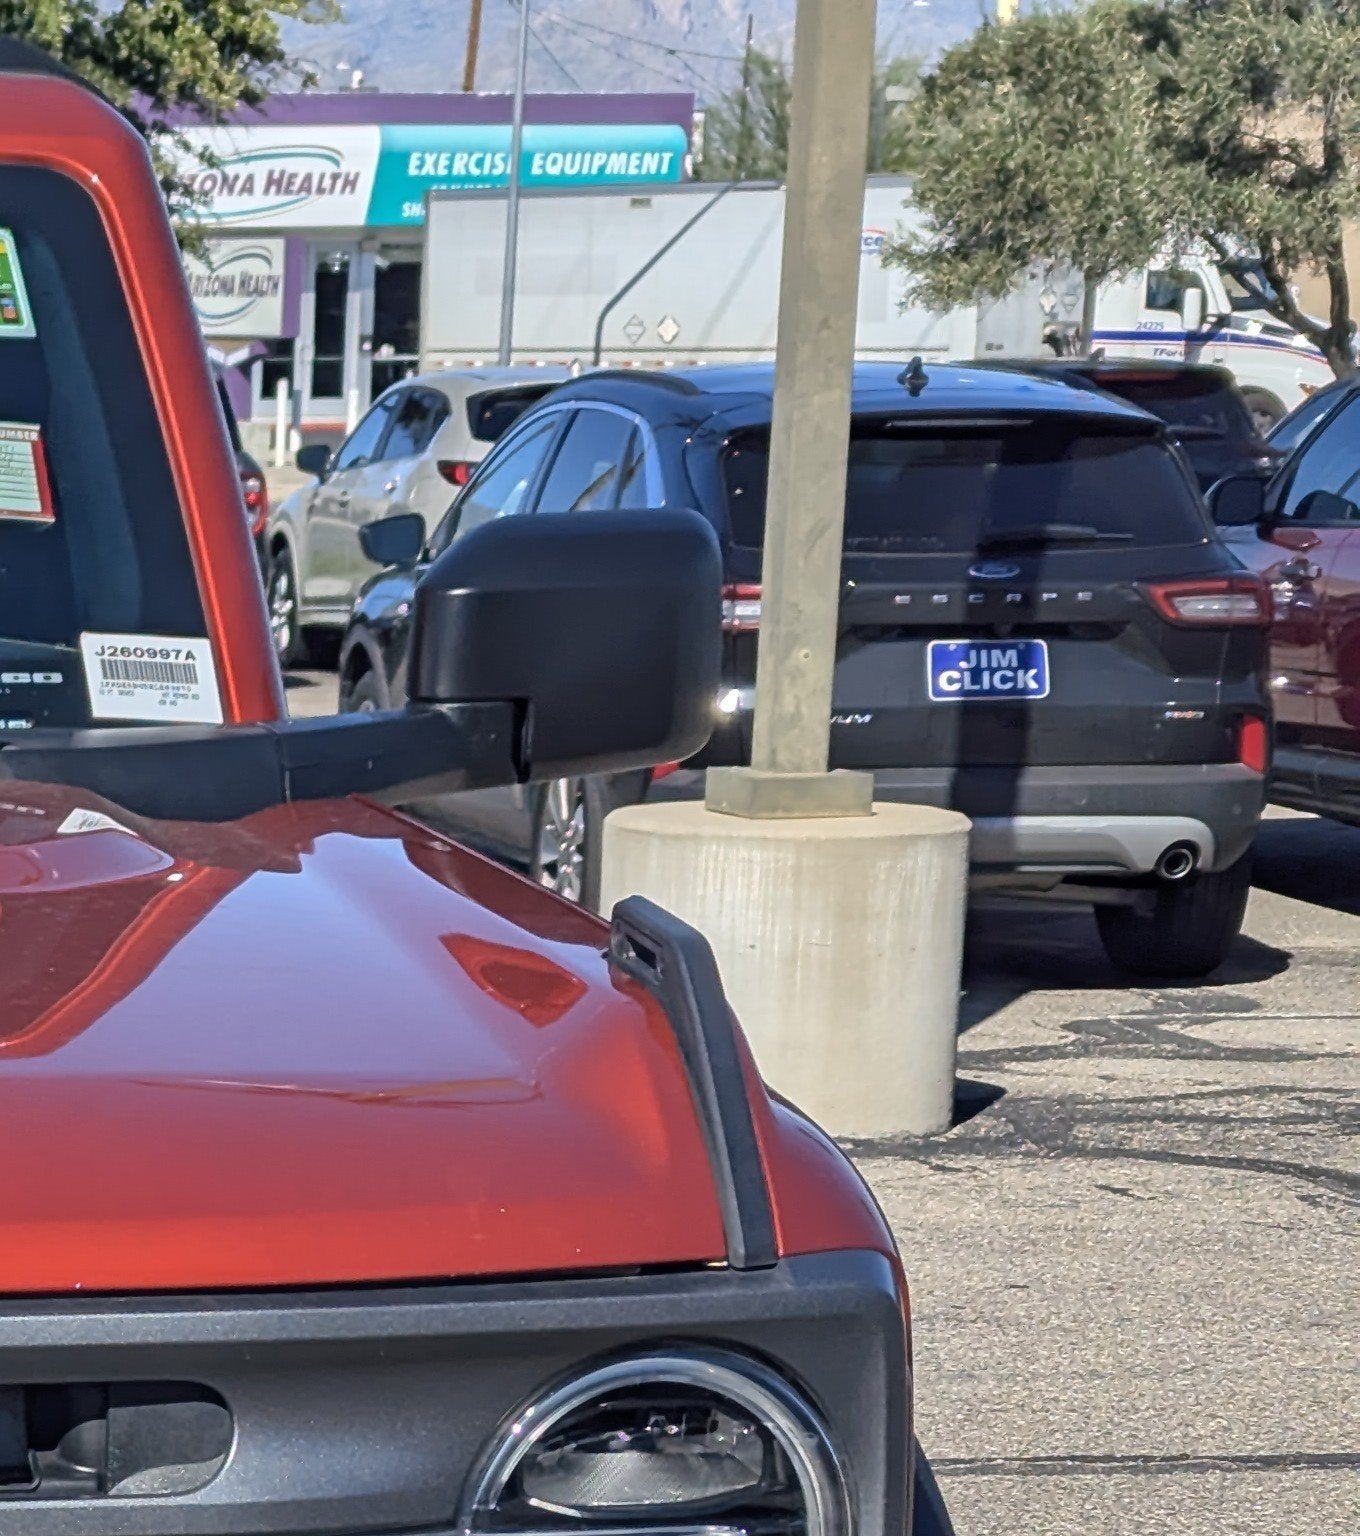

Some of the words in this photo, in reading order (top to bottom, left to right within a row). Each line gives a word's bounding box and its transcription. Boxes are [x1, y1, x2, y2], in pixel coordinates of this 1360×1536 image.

[531, 152, 674, 176] EQUIPMENT
[263, 169, 361, 196] HEALTH
[894, 591, 1094, 605] ESCAPE
[959, 649, 1019, 669] JIM
[938, 669, 1040, 691] CLICK
